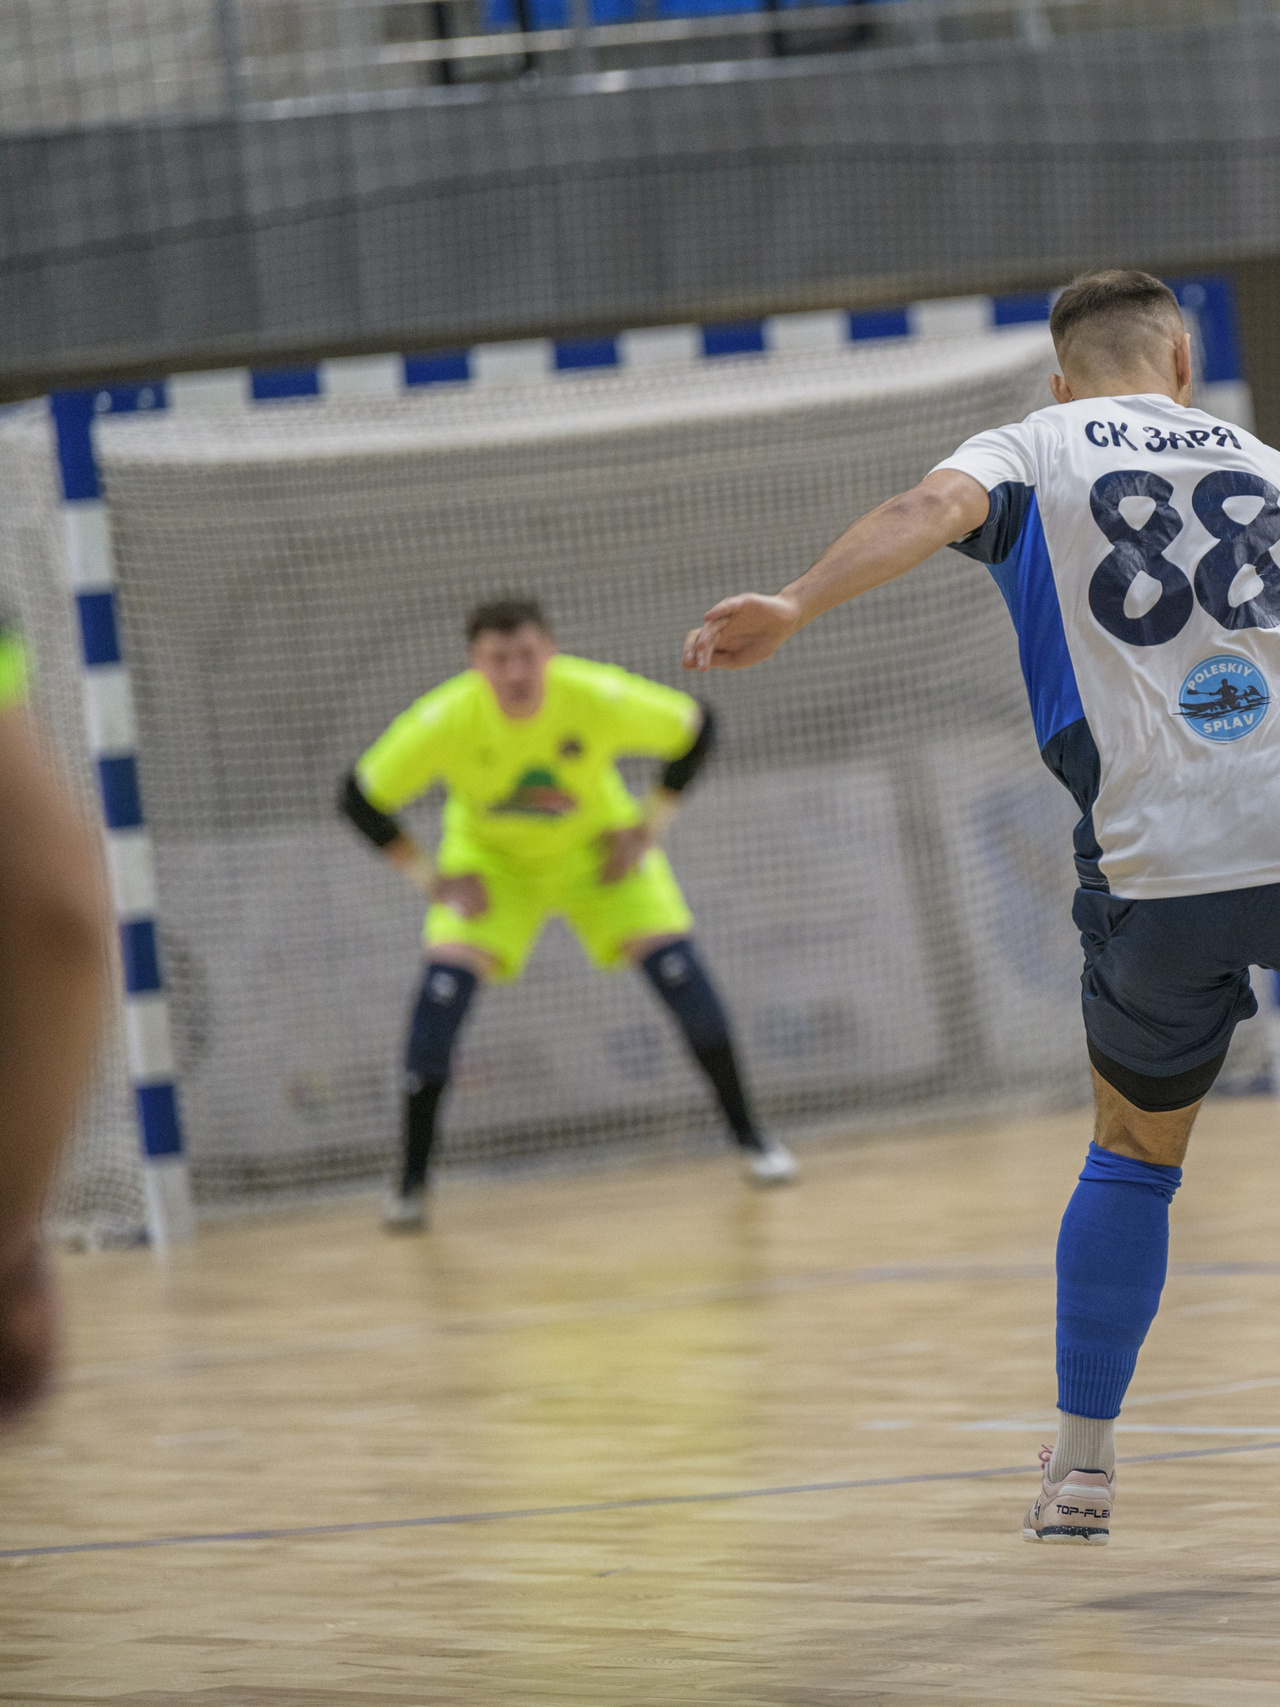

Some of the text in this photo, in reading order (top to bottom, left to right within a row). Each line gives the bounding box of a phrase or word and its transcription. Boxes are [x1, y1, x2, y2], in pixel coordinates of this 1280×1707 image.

[1084, 420, 1242, 452] СК ЗАРЯ
[1186, 662, 1254, 691] POLESKIY
[1202, 713, 1255, 734] SPLAV
